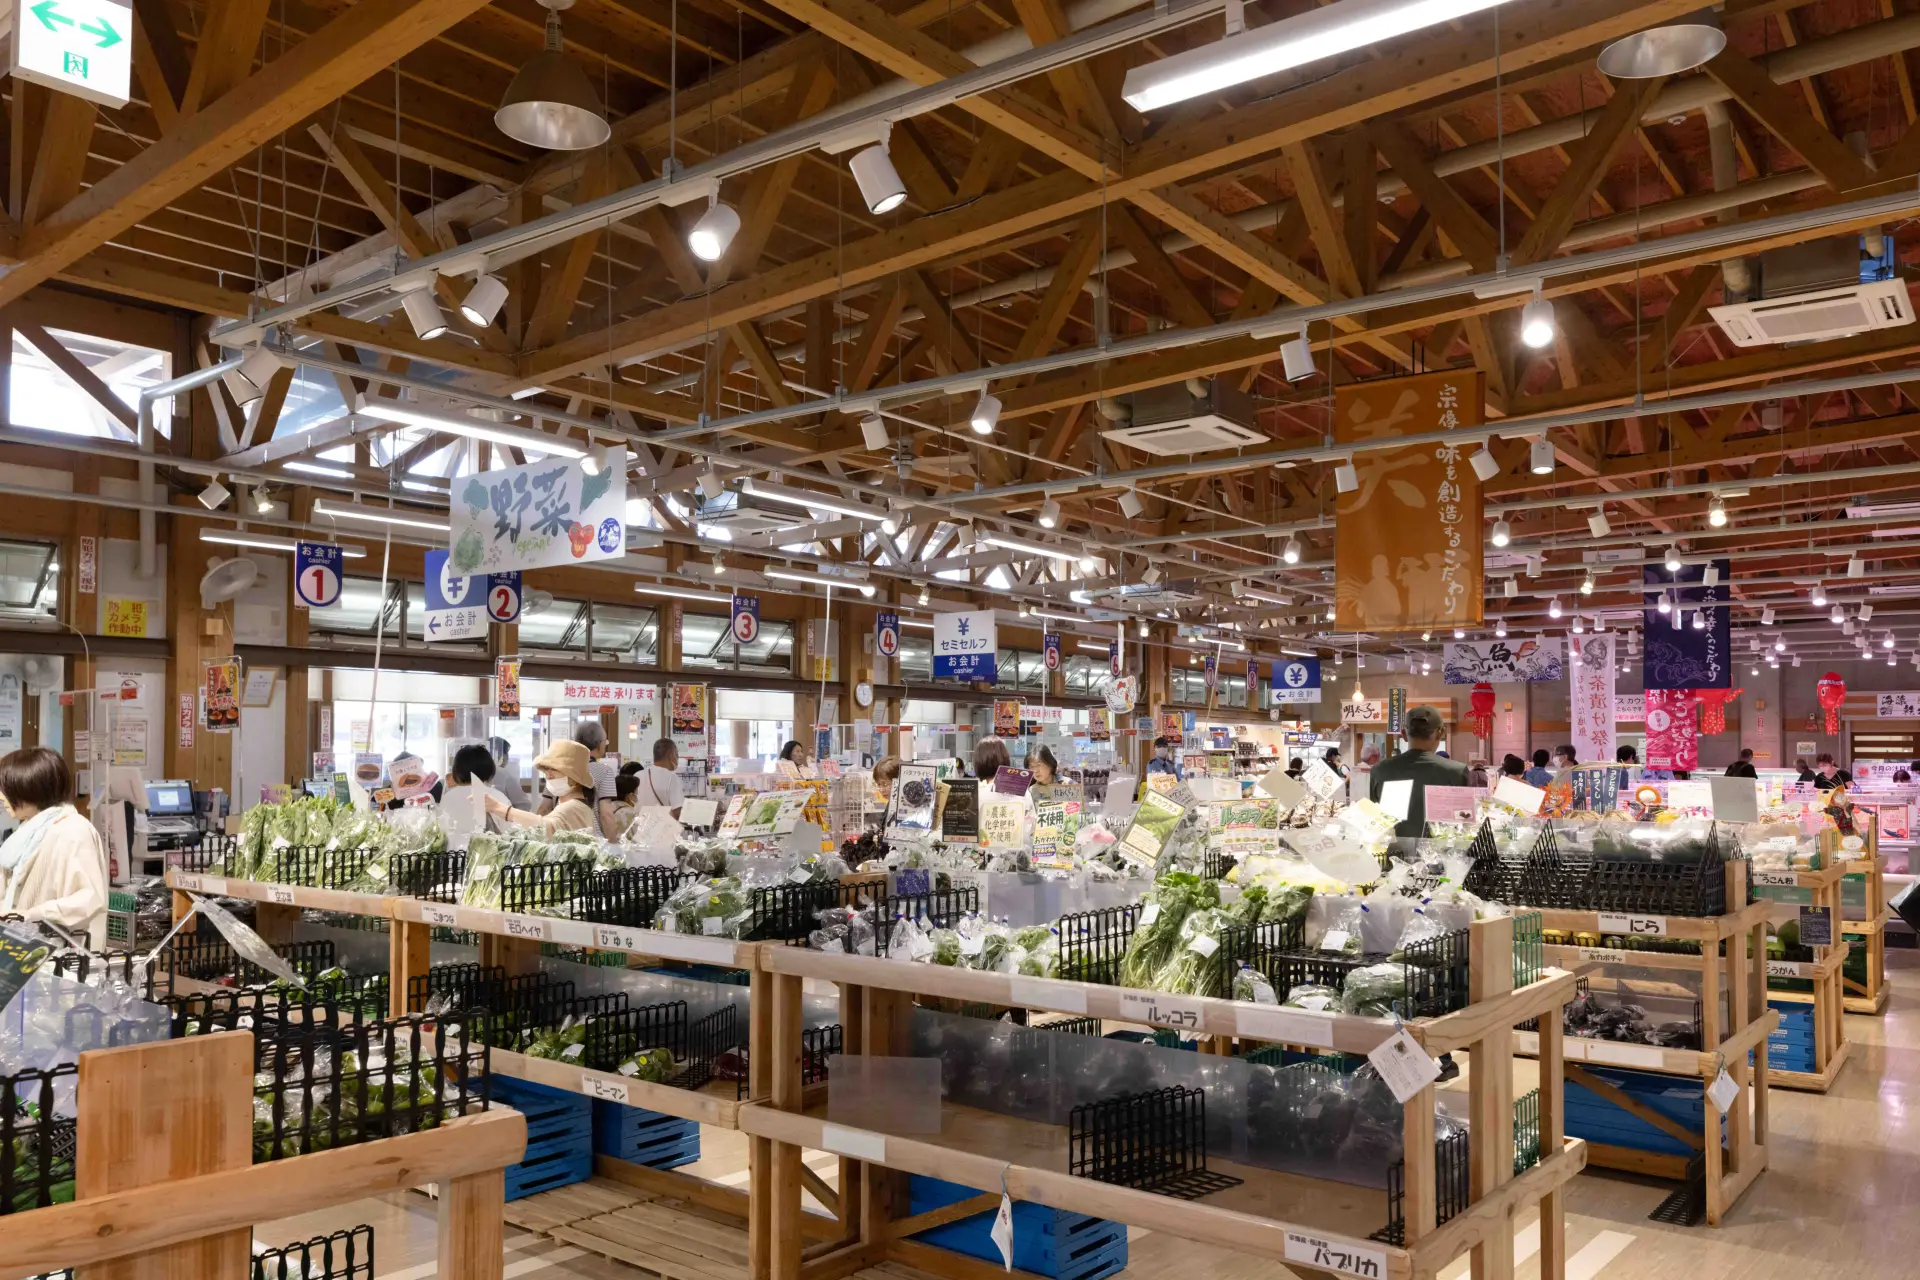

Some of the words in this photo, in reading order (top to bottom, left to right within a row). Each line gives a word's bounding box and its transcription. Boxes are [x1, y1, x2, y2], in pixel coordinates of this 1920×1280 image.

[490, 465, 576, 543] 野菜
[1435, 383, 1463, 614] 宗像味を創造するこだわり
[302, 545, 337, 559] お会計
[308, 556, 331, 565] cashier
[312, 569, 324, 601] 1
[108, 601, 142, 613] 防犯
[496, 588, 511, 618] 2
[736, 598, 757, 607] お会計
[108, 612, 141, 624] カメラ
[444, 610, 477, 627] お会計
[880, 615, 896, 623] お会計
[108, 623, 141, 634] 作動中
[449, 626, 471, 637] cashier
[740, 614, 752, 639] 3
[958, 617, 970, 636] ¥
[883, 630, 894, 652] 4
[941, 638, 988, 651] セミセルフ
[948, 655, 980, 667] お会計
[1048, 648, 1057, 668] 5
[1489, 641, 1516, 672] 魚
[1113, 656, 1119, 674] 6
[1290, 667, 1303, 685] ¥
[564, 684, 655, 700] 地方配送承ります
[1288, 690, 1314, 698] お会計
[1343, 702, 1375, 719] 明太子
[1607, 769, 1617, 798] コシヒカリ
[990, 805, 1008, 818] 農薬
[1151, 795, 1179, 814] オカワカメ
[1037, 811, 1064, 828] 不使用
[1220, 806, 1263, 826] ルッコラ
[985, 819, 1015, 831] 化学肥料
[988, 831, 1012, 842] 不使用
[1034, 835, 1063, 845] おかわかめ
[1762, 876, 1794, 885] うこん粉
[433, 912, 455, 924] こまつな
[1807, 906, 1823, 914] 冬瓜
[508, 922, 541, 938] モロヘイヤ
[1629, 918, 1660, 934] にら
[601, 935, 633, 948] ひゆな
[1147, 1006, 1198, 1028] ルッコラ
[594, 1083, 626, 1100] ピーマン
[1314, 1247, 1378, 1278] パプリカ
